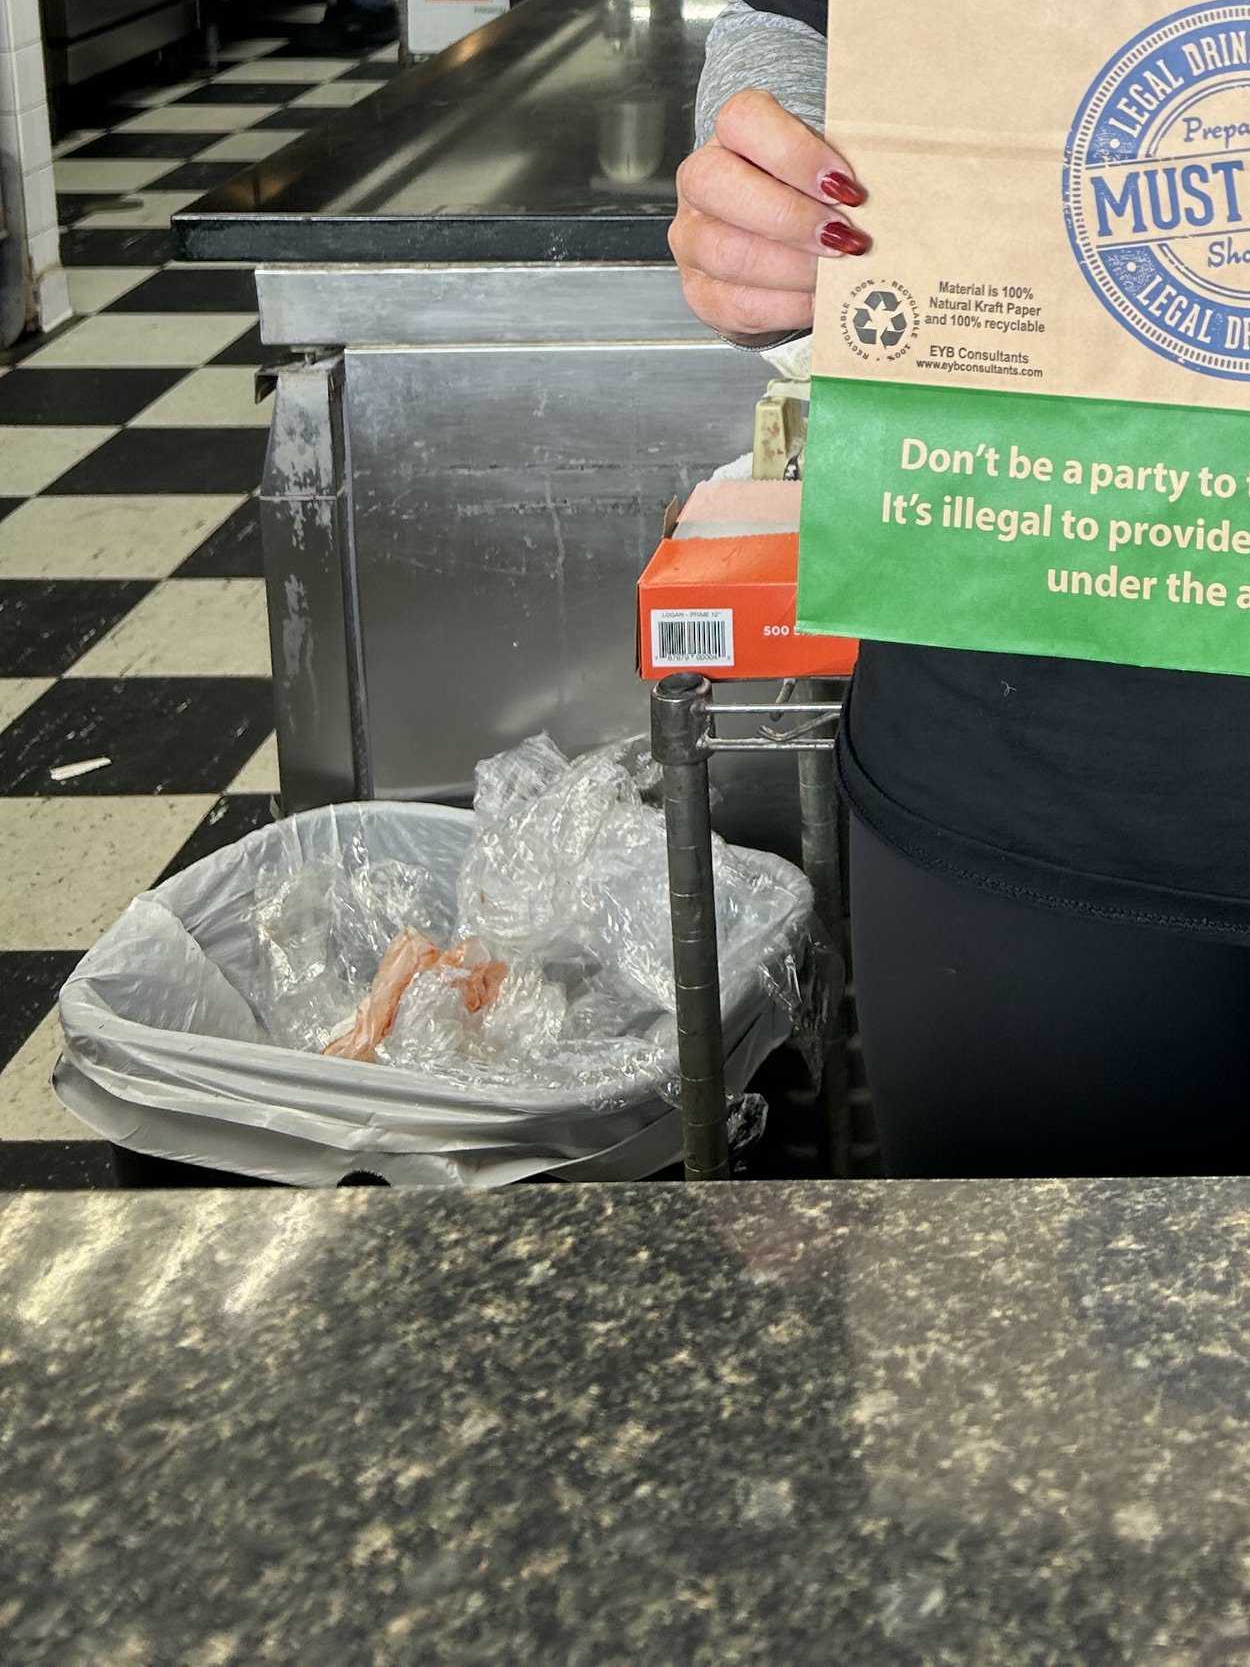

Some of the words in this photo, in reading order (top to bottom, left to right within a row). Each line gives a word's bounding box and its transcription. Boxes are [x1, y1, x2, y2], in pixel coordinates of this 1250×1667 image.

[1109, 60, 1184, 138] LEGAL
[1090, 160, 1244, 237] MUST
[851, 279, 875, 297] 100%
[891, 281, 920, 339] RECYCLABLE
[929, 296, 971, 311] Natural
[974, 300, 1004, 314] Kraft
[1006, 302, 1042, 318] Paper
[938, 281, 985, 296] Material
[988, 284, 999, 297] is
[1002, 286, 1034, 300] 100%
[1136, 274, 1215, 343] LEGAL
[840, 302, 869, 360] RECYCLABLE
[925, 314, 947, 325] and
[950, 315, 981, 329] 100%
[984, 319, 1046, 333] recyclable
[886, 343, 911, 361] 100%
[916, 359, 1043, 378] www.eybconsultants.com
[929, 345, 955, 358] EYB
[958, 347, 1030, 364] Consultants
[900, 438, 1000, 477] Don't
[1009, 445, 1053, 482] be
[1062, 459, 1084, 484] a
[1090, 462, 1191, 503] party
[1198, 467, 1237, 499] to
[882, 491, 933, 526] It's
[942, 495, 1052, 542] illegal
[1061, 510, 1099, 541] to
[1047, 564, 1158, 601] under
[1166, 570, 1228, 607] the
[763, 625, 790, 636] 500
